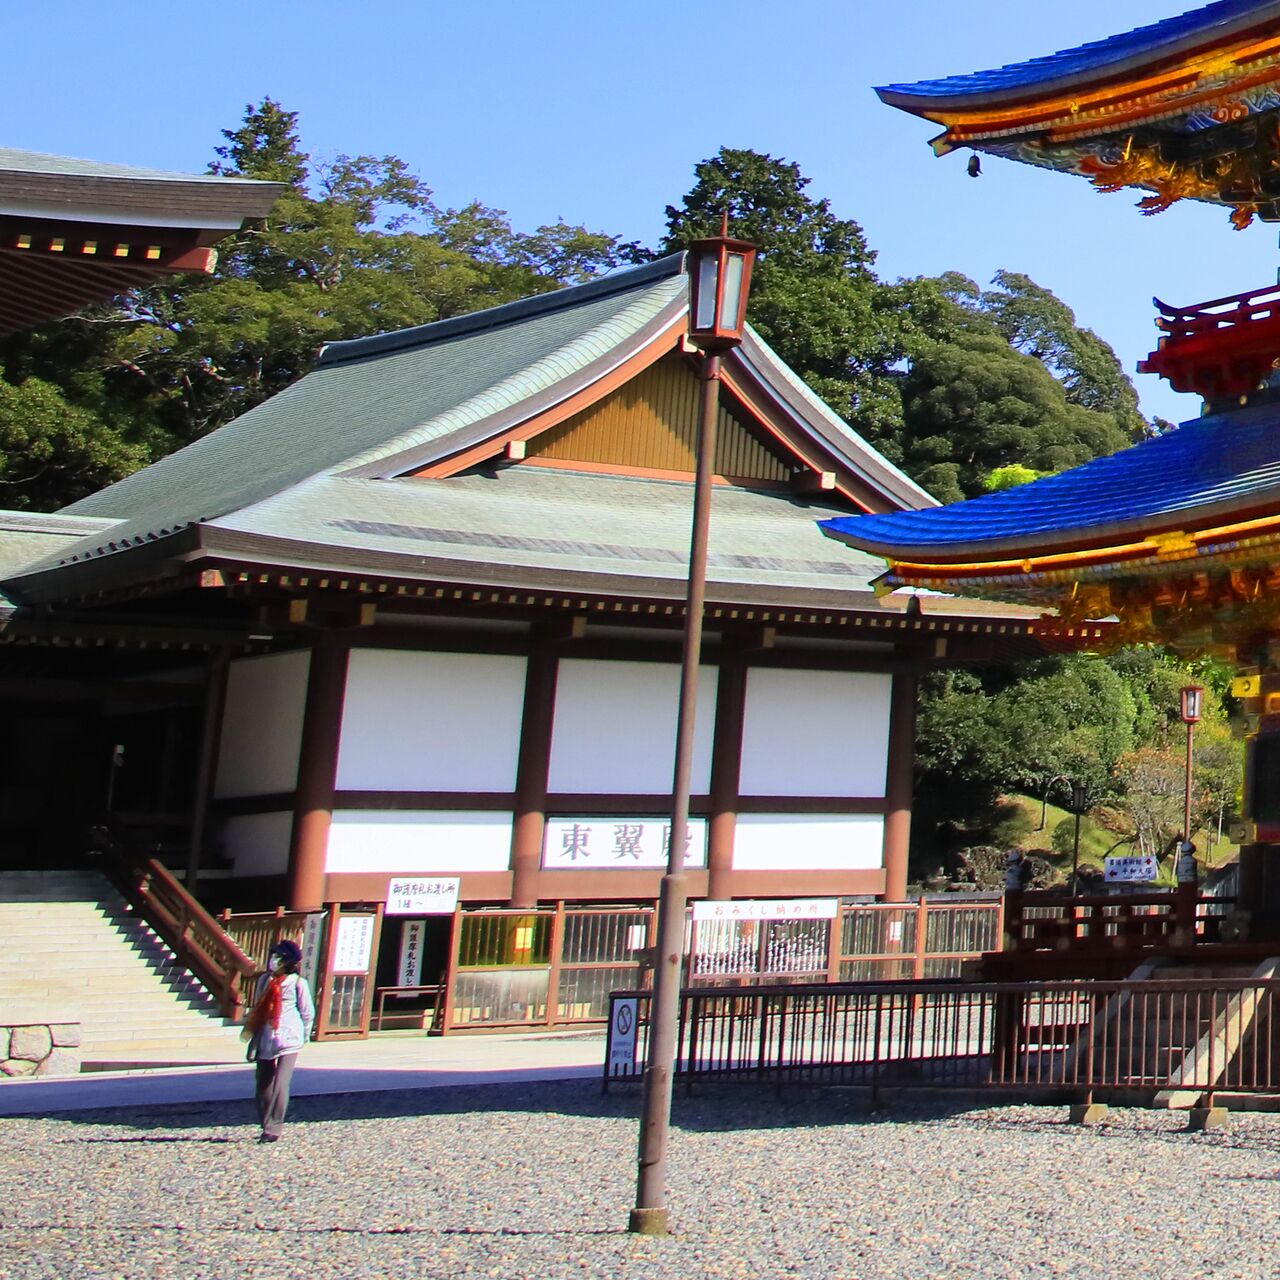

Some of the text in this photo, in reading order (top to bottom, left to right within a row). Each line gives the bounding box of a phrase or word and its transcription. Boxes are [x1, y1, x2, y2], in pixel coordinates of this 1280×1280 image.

[715, 904, 818, 916] おみくじ納め所
[405, 924, 420, 987] 御護摩札お渡し
